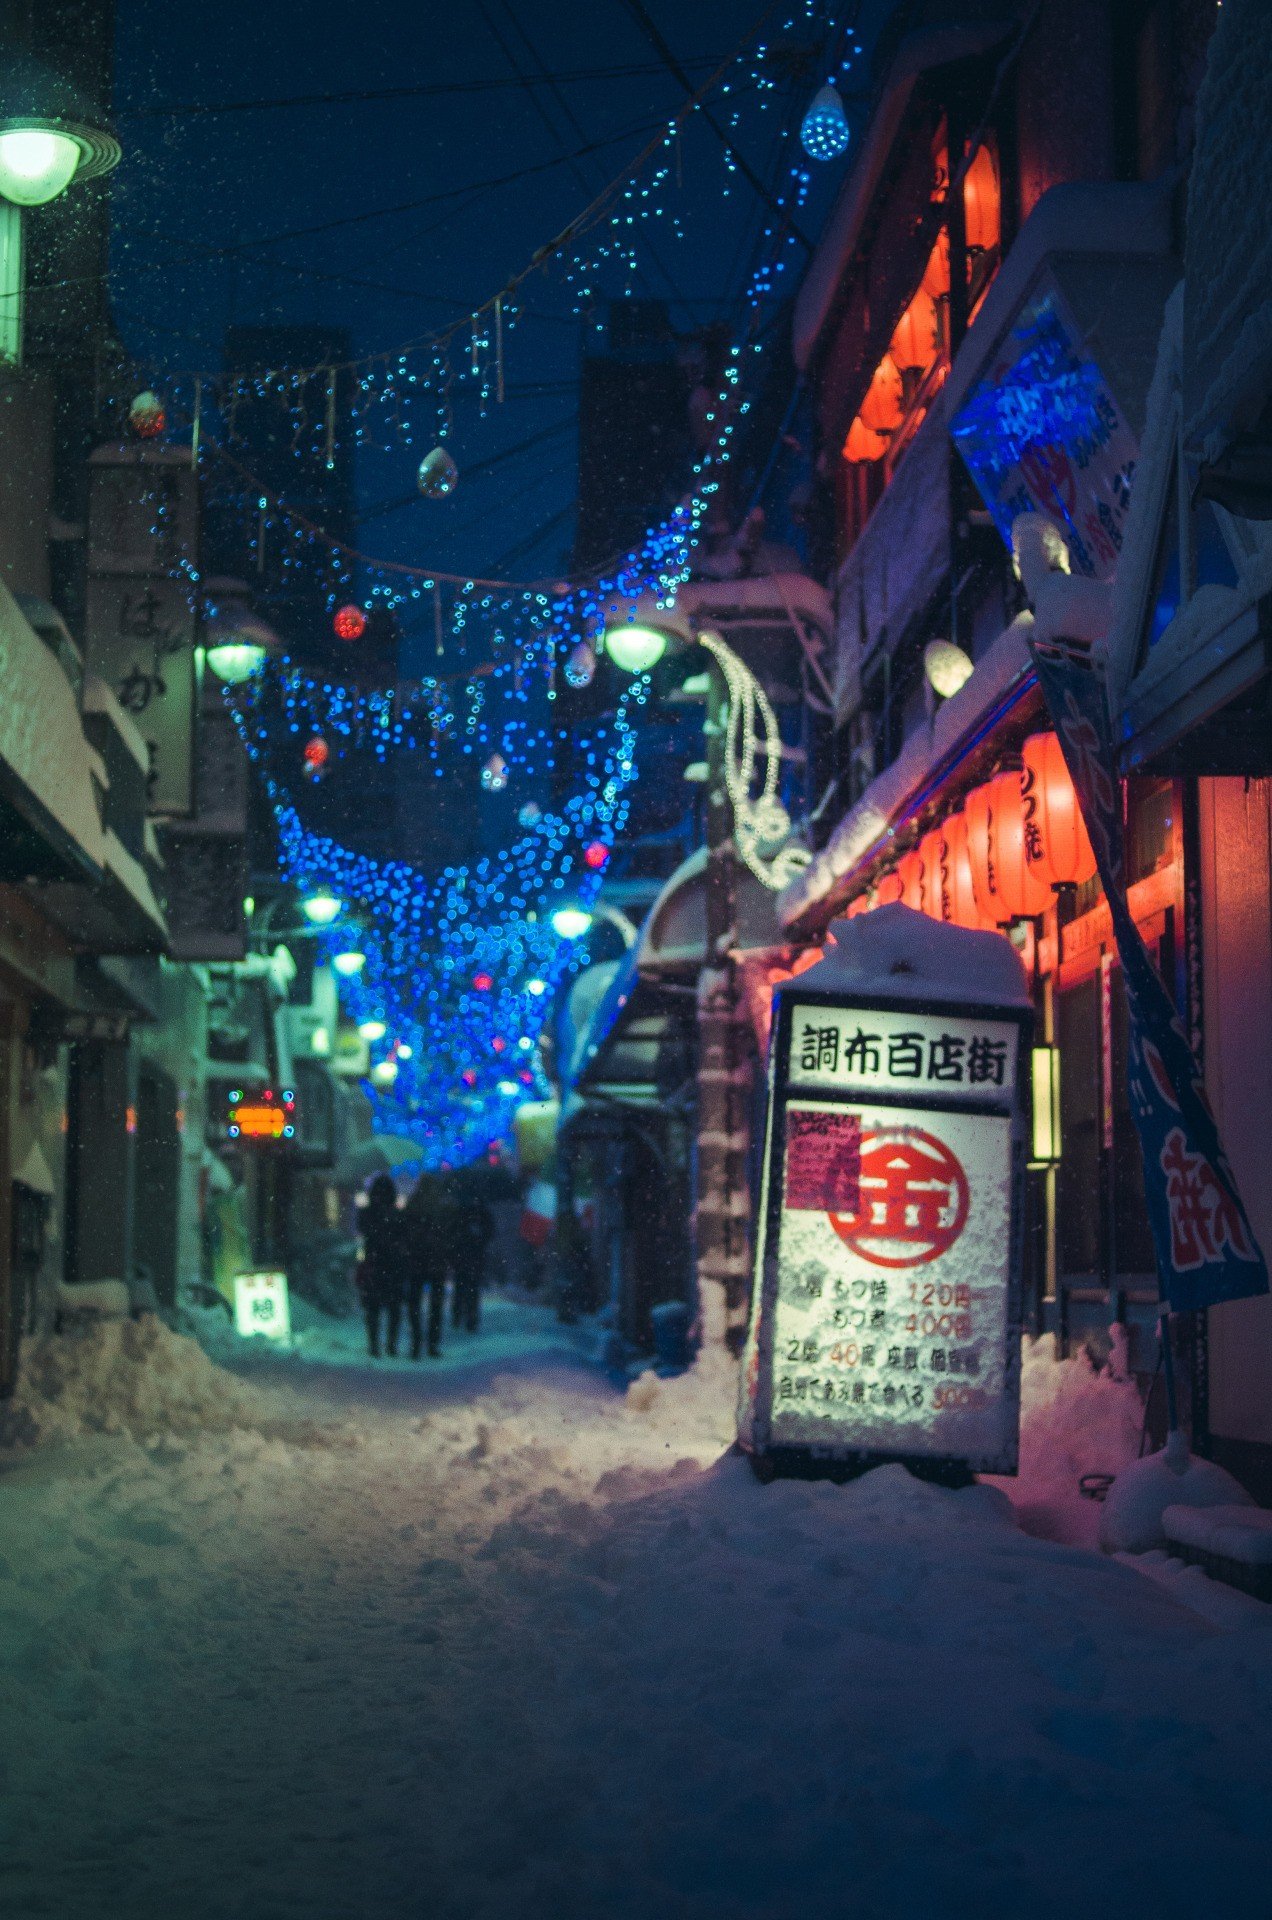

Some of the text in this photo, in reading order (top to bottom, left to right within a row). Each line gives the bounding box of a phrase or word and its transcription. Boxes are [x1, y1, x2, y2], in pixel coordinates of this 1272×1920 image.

[800, 1023, 1008, 1086] 調布百店街
